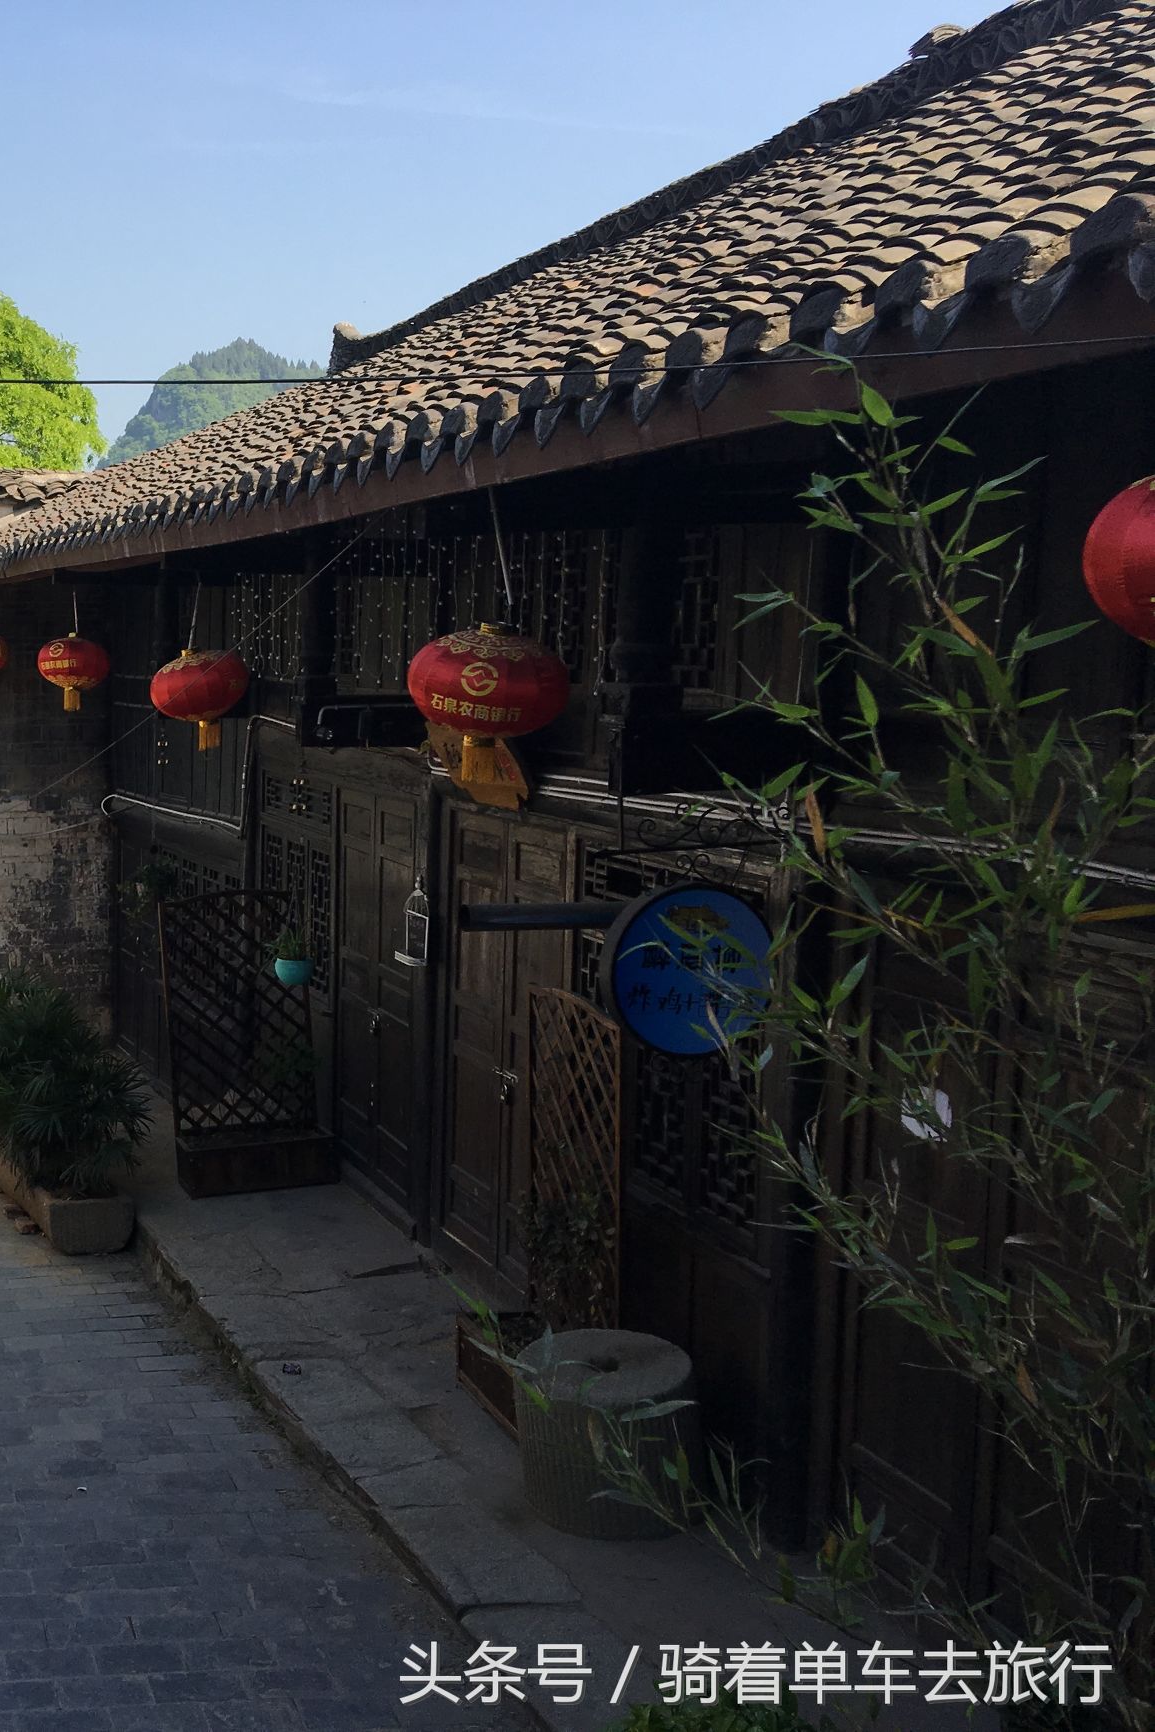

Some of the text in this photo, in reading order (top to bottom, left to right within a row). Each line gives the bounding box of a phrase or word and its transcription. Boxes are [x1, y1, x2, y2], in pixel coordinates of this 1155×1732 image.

[431, 693, 522, 722] 石泉农商银行
